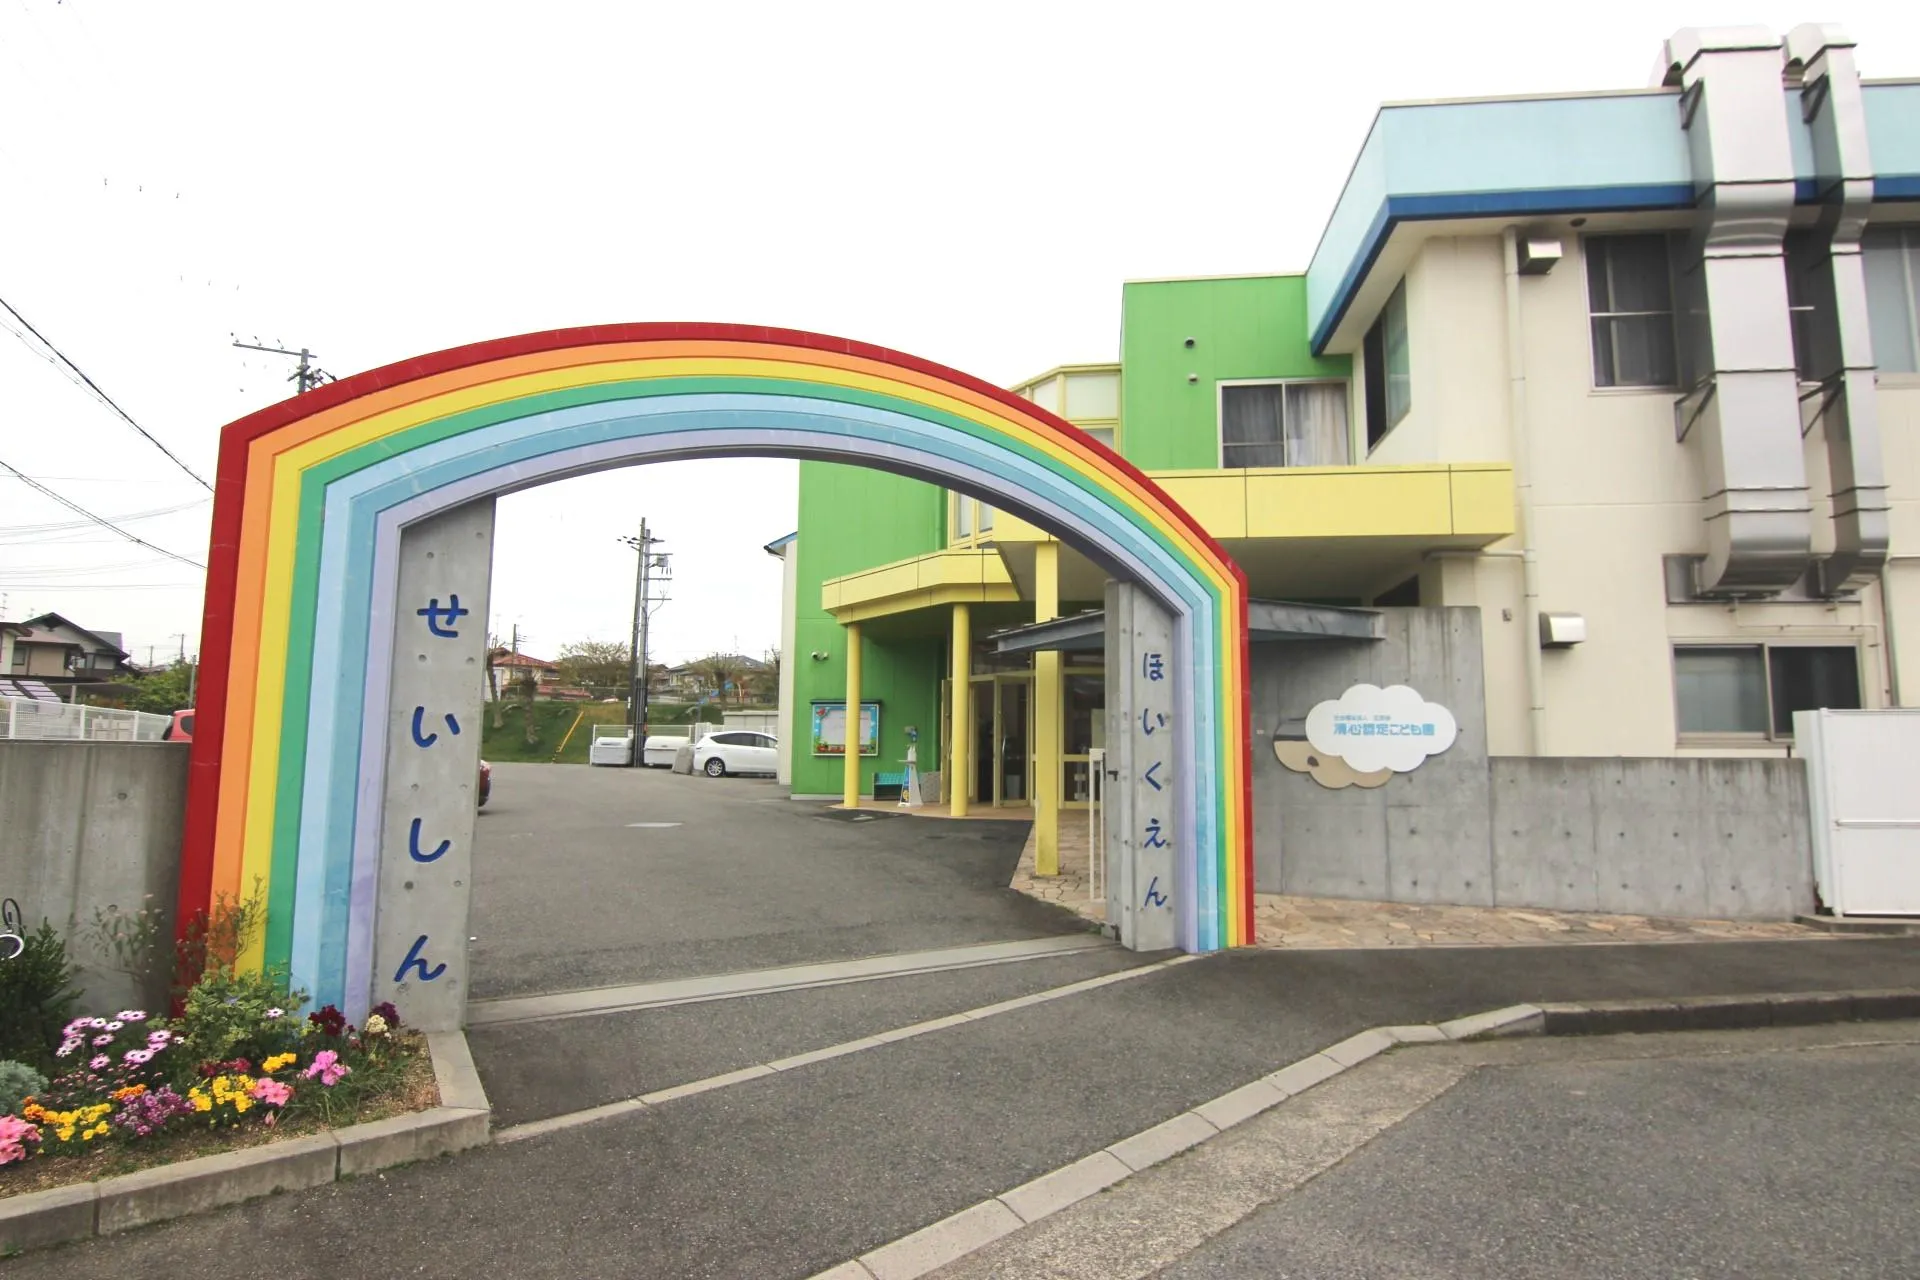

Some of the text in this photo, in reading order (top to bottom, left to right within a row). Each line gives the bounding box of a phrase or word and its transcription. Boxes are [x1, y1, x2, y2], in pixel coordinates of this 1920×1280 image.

[394, 594, 469, 982] せいしん
[1143, 652, 1168, 907] ほいくえん
